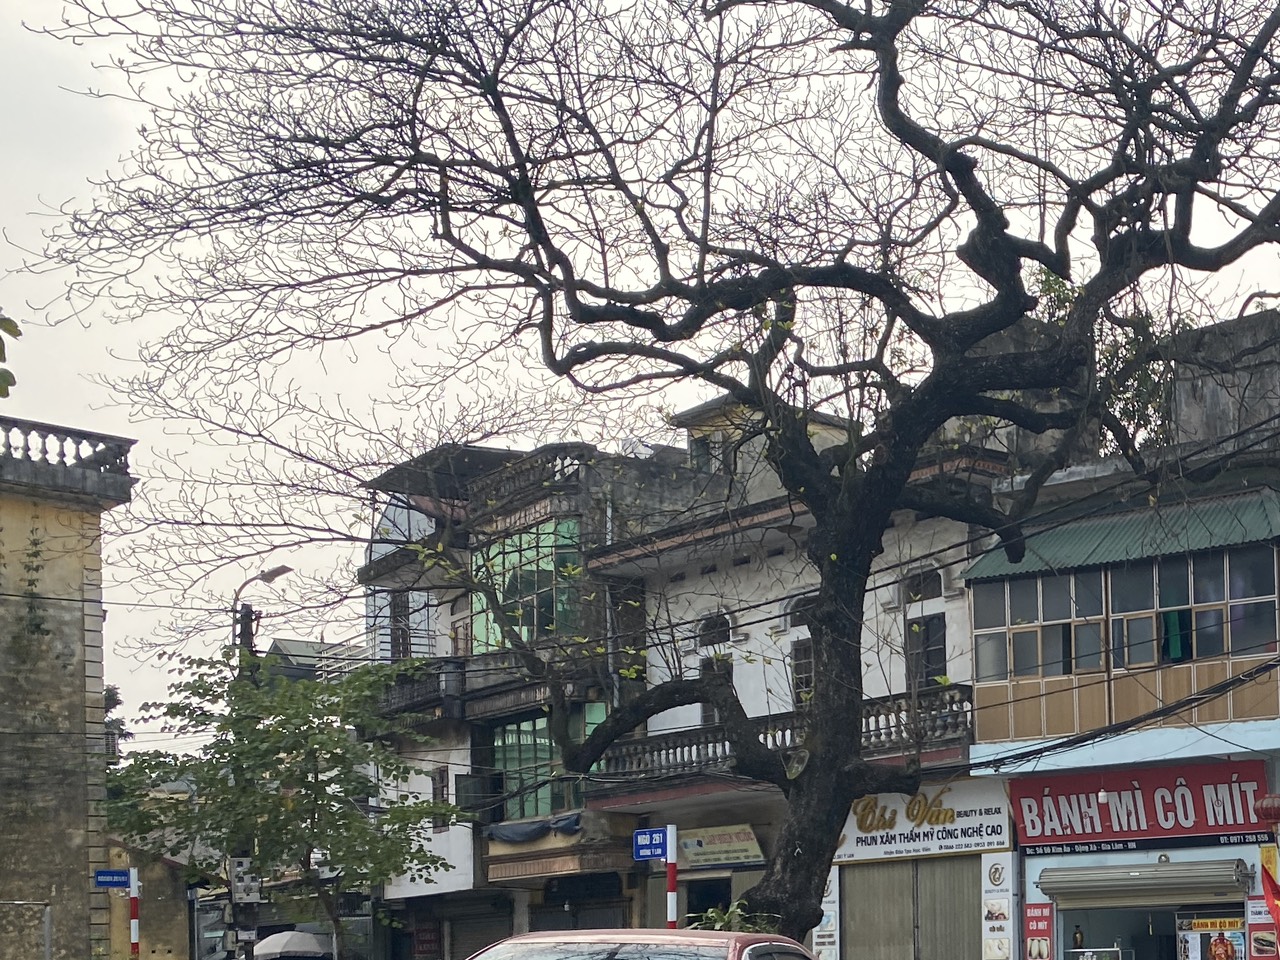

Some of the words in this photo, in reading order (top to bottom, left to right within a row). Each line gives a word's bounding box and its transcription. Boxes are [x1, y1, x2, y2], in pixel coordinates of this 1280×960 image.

[1020, 787, 1103, 838] BÁNH
[1106, 780, 1148, 833] MÌ
[1153, 777, 1196, 830] CÔ
[1202, 773, 1259, 827] MÍT
[956, 810, 978, 819] BEAUTY
[984, 806, 1002, 816] RELAX
[653, 833, 663, 844] 261
[856, 835, 878, 847] PHUN
[880, 831, 897, 845] XĂM
[922, 827, 935, 842] MỸ
[936, 827, 959, 841] CÔNG
[960, 823, 984, 839] NGHỆ
[985, 824, 1003, 836] CAO
[1027, 907, 1041, 917] BÁNH
[1043, 907, 1050, 916] MÌ
[1029, 920, 1036, 930] CÔ
[1038, 920, 1047, 930] MÍT
[1193, 920, 1209, 929] BÁNH
[1210, 920, 1217, 929] MÌ
[1219, 920, 1226, 928] CÔ
[1228, 920, 1238, 928] MÍT
